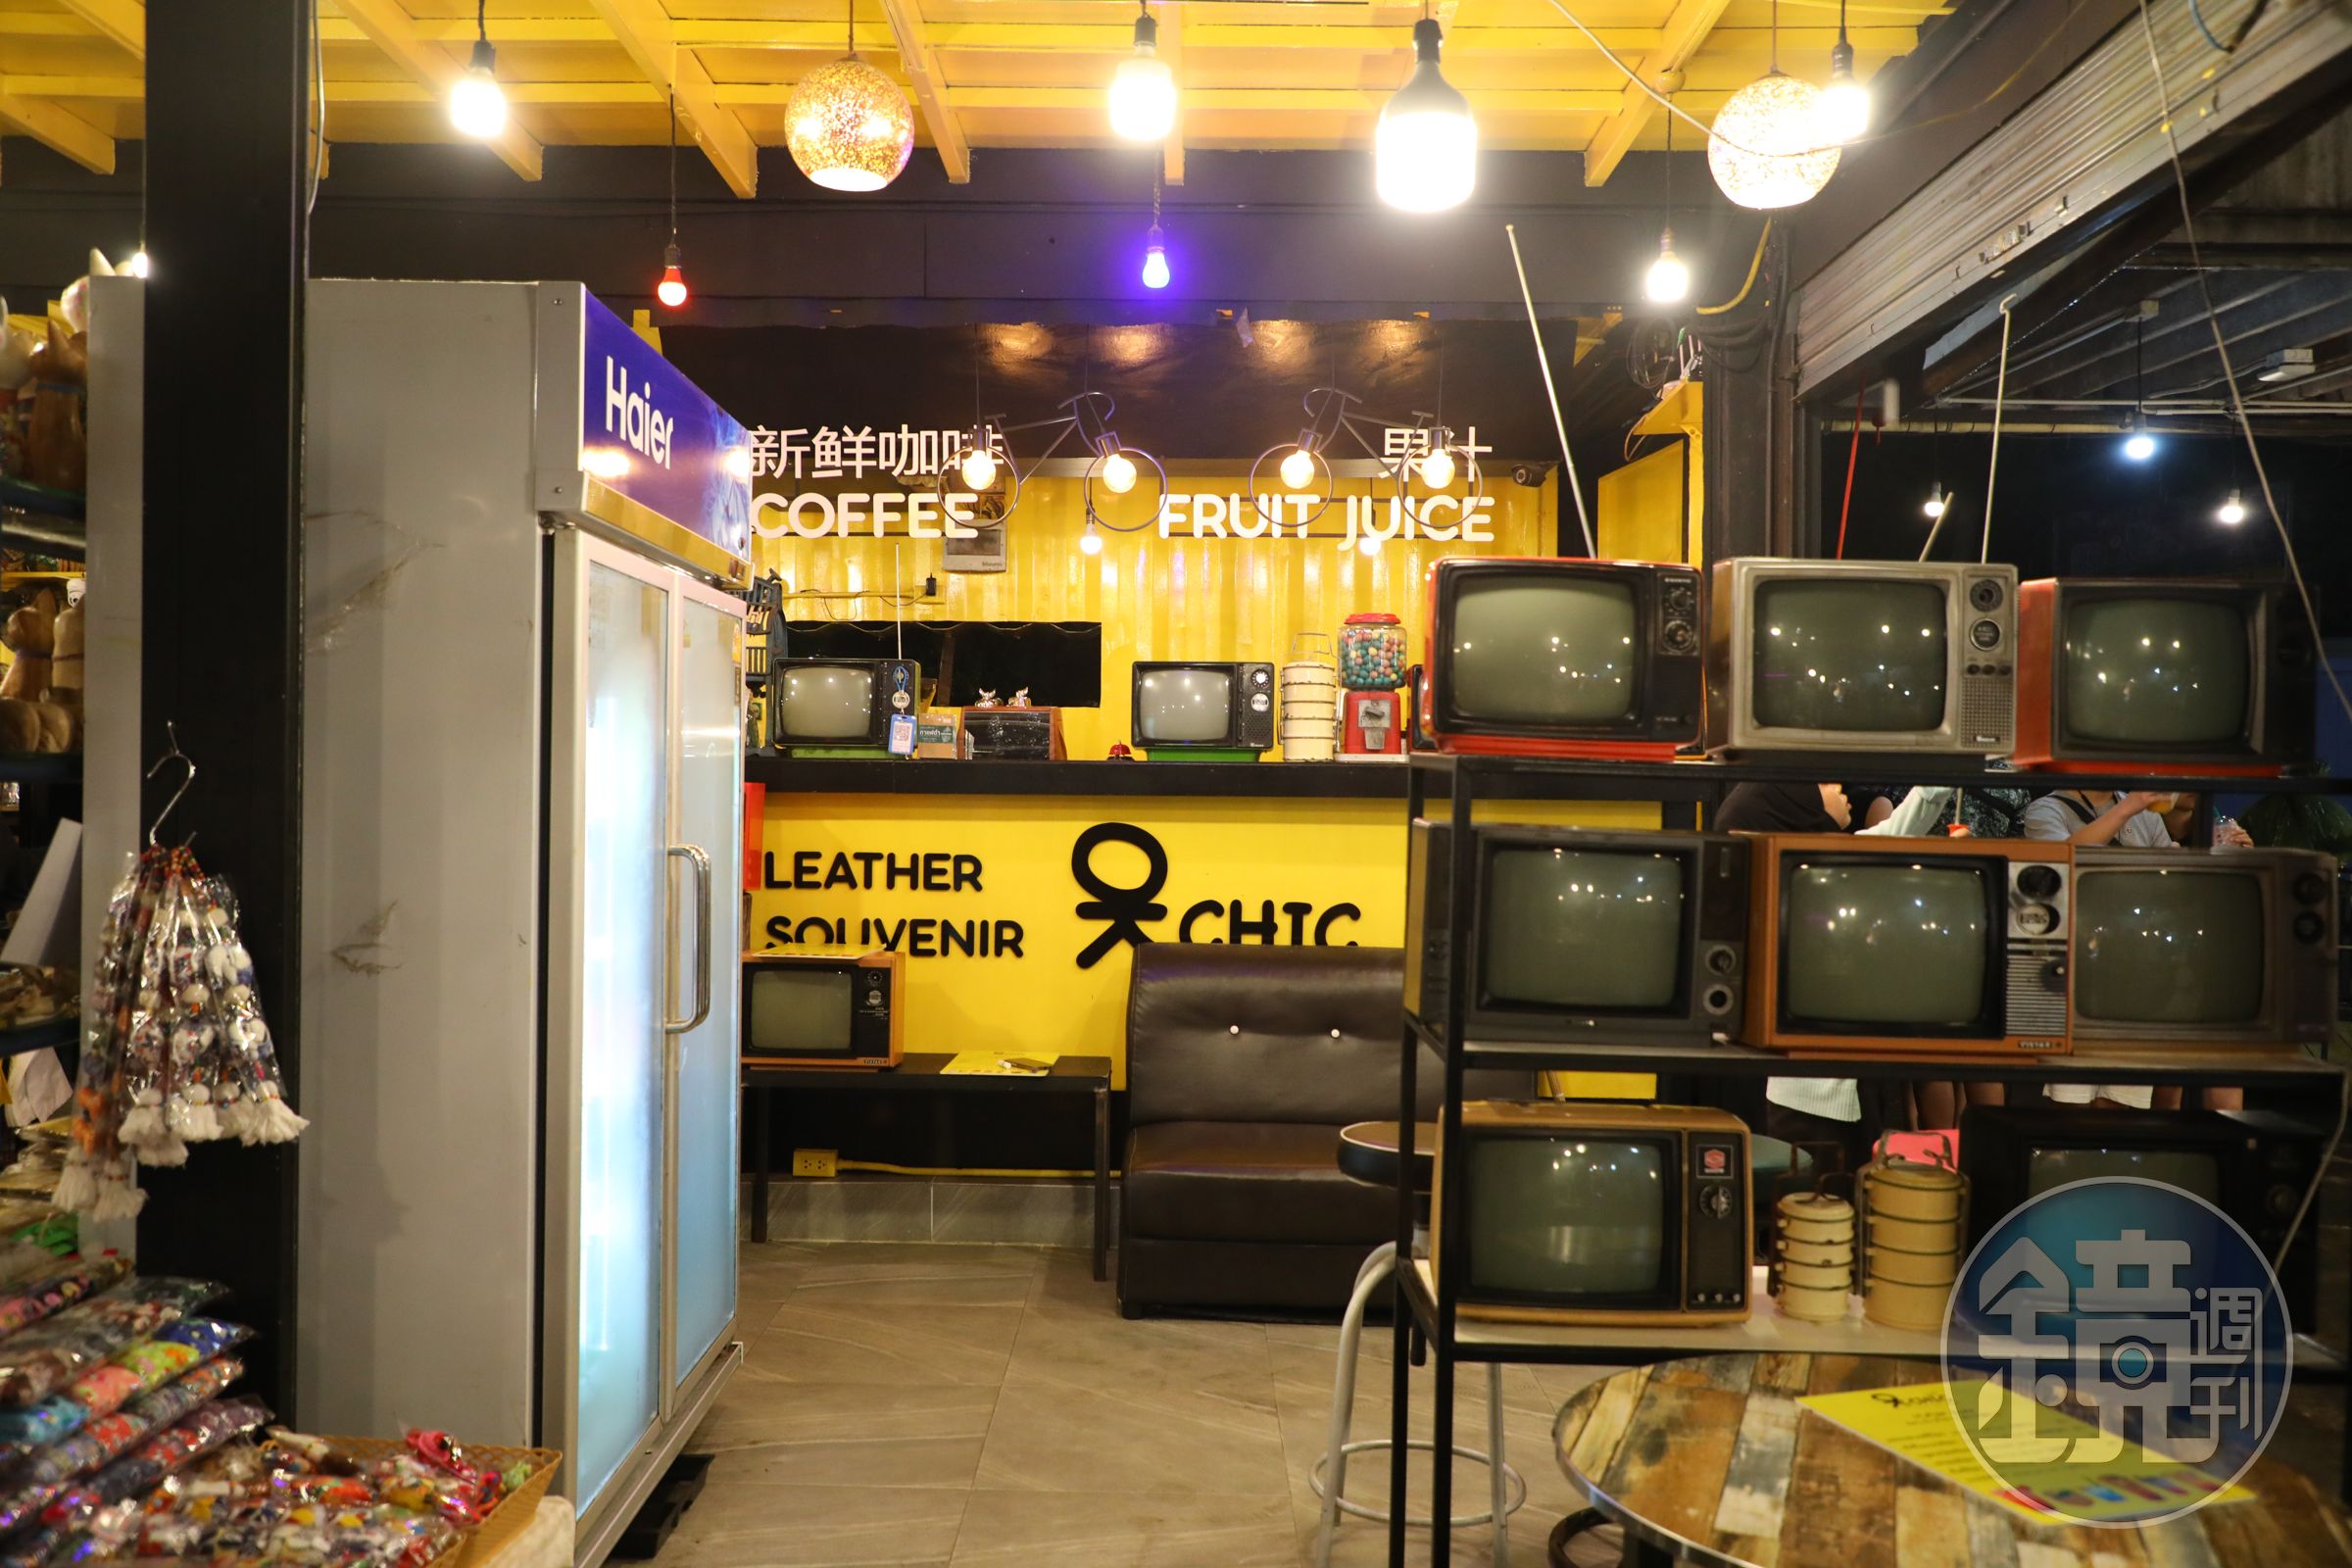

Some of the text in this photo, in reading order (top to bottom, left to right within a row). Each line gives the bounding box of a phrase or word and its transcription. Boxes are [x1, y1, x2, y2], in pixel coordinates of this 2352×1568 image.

[606, 355, 674, 470] Haier
[751, 492, 979, 539] COFFEE
[1158, 493, 1495, 552] FRUIT JUICE
[764, 851, 983, 892] LEATHER
[766, 915, 1024, 957] SOUVENIR
[1179, 899, 1361, 947] CHIC
